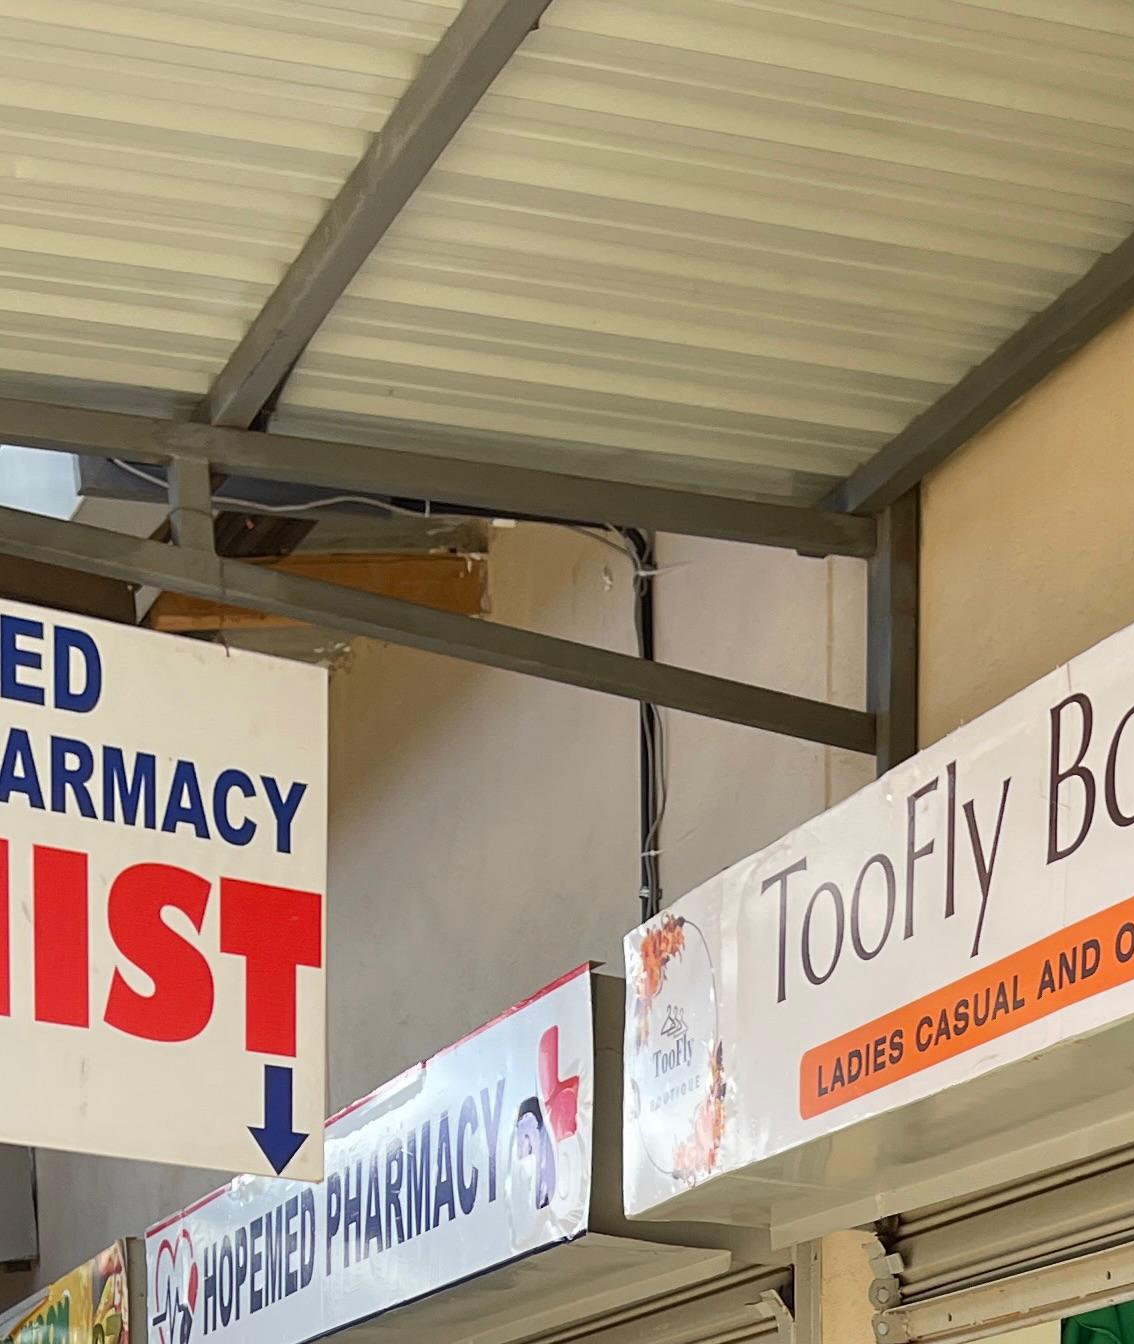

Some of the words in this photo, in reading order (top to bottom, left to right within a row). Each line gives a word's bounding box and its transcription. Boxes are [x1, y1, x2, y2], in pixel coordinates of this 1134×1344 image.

[0, 838, 322, 1058] IST
[761, 762, 1011, 1004] TooFly
[817, 1029, 904, 1098] LADIES
[915, 975, 1025, 1053] CASUAL
[1038, 925, 1101, 1000] AND
[203, 1187, 316, 1335] HOPEMED
[326, 1080, 506, 1277] PHARMACY
